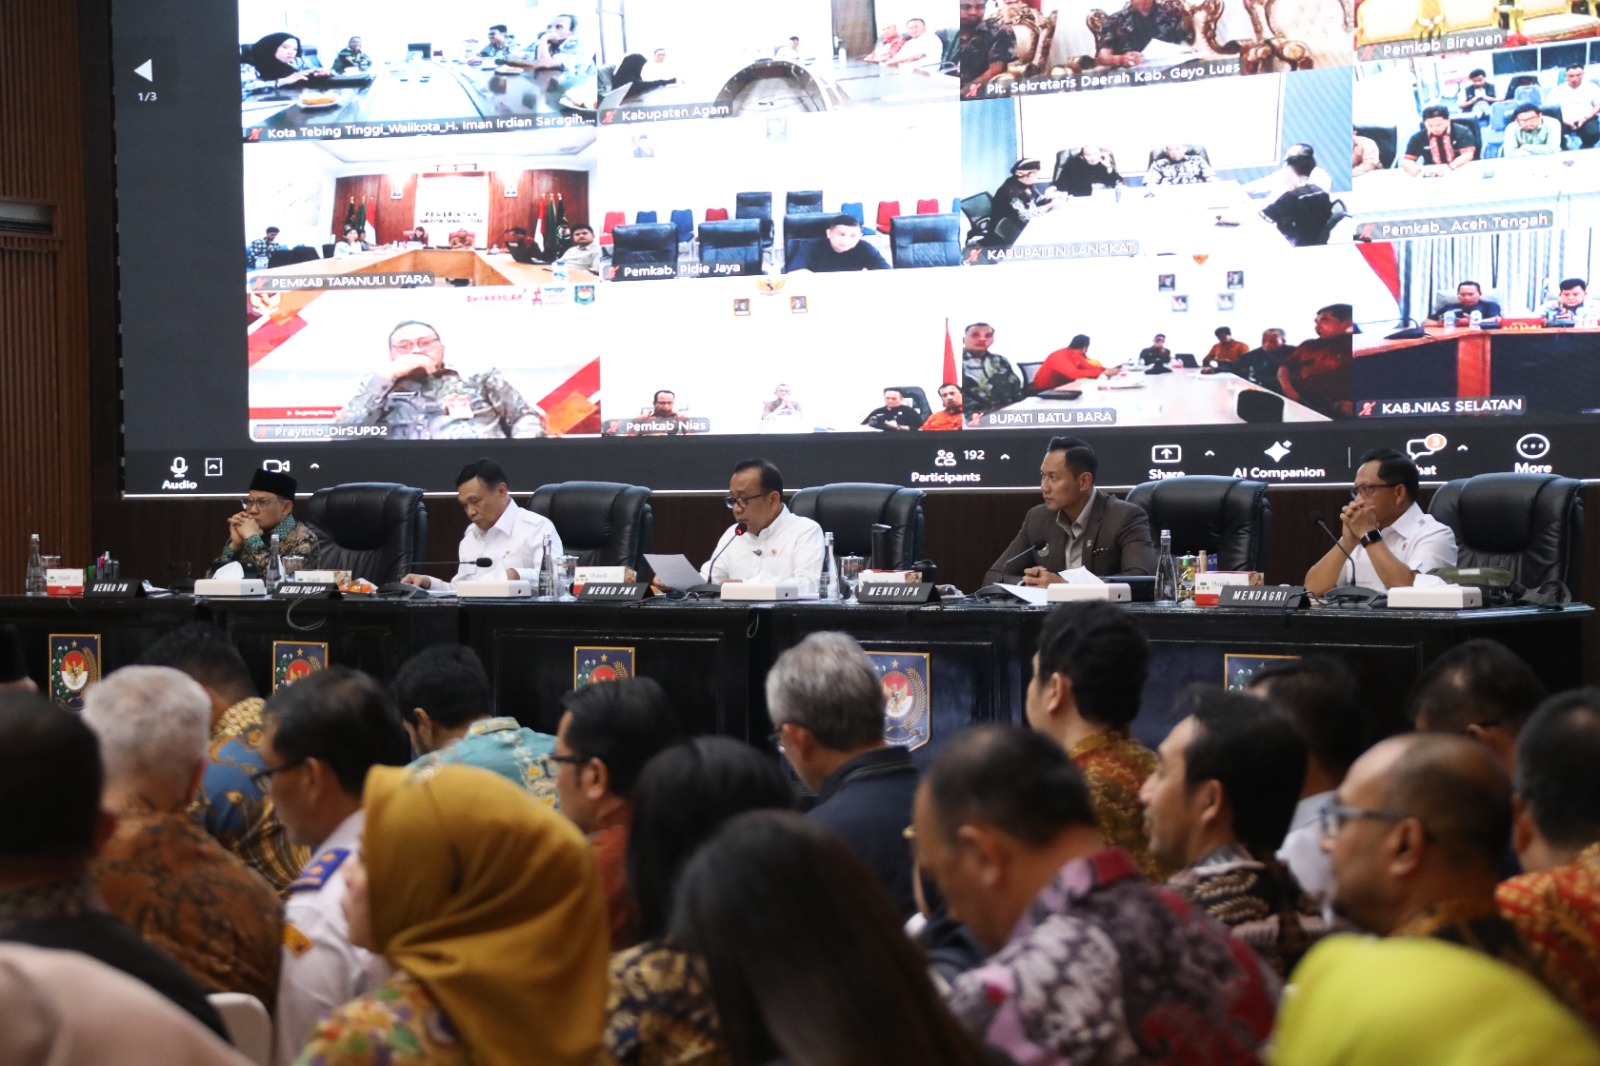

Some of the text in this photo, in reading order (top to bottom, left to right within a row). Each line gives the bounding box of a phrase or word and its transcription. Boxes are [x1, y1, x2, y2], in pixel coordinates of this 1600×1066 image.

[1383, 33, 1503, 56] Pemkab Bireuen
[986, 63, 1241, 94] Plt. Sekretaris Daerah Kab. Gayo Lues
[137, 91, 158, 102] 1/3
[621, 105, 729, 121] Kabupaten Agam
[267, 128, 297, 139] Kota
[300, 126, 342, 138] Tebing
[345, 122, 459, 137] Tinggi_Walikota_H.
[463, 120, 493, 130] Iman
[497, 117, 533, 129] Irdian
[1451, 217, 1488, 231] Aceh
[1492, 213, 1548, 229] Tengah
[987, 241, 1135, 260] KABUPATEN LANGKAT
[624, 263, 741, 277] Pemkab. Pidie Jaya
[272, 274, 432, 288] PEMKAB TAPANULI UTARA
[1382, 398, 1522, 414] KAB.NIAS SELATAN
[989, 411, 1112, 424] BUPATI BATU BARA
[626, 419, 706, 431] Pemkab Nias
[274, 426, 389, 438] Prayitno_DirSUPD2
[963, 449, 985, 461] 192
[1148, 468, 1185, 480] Share
[1232, 467, 1325, 481] AI Companion
[1415, 464, 1437, 475] hat
[1514, 462, 1553, 474] More
[911, 471, 981, 484] Participants
[162, 479, 198, 490] Audio
[92, 583, 129, 592] MENKO PM
[587, 586, 638, 596] MENKO PMK
[868, 586, 921, 597] MENKO IPK
[1232, 590, 1288, 602] MENDAGRI
